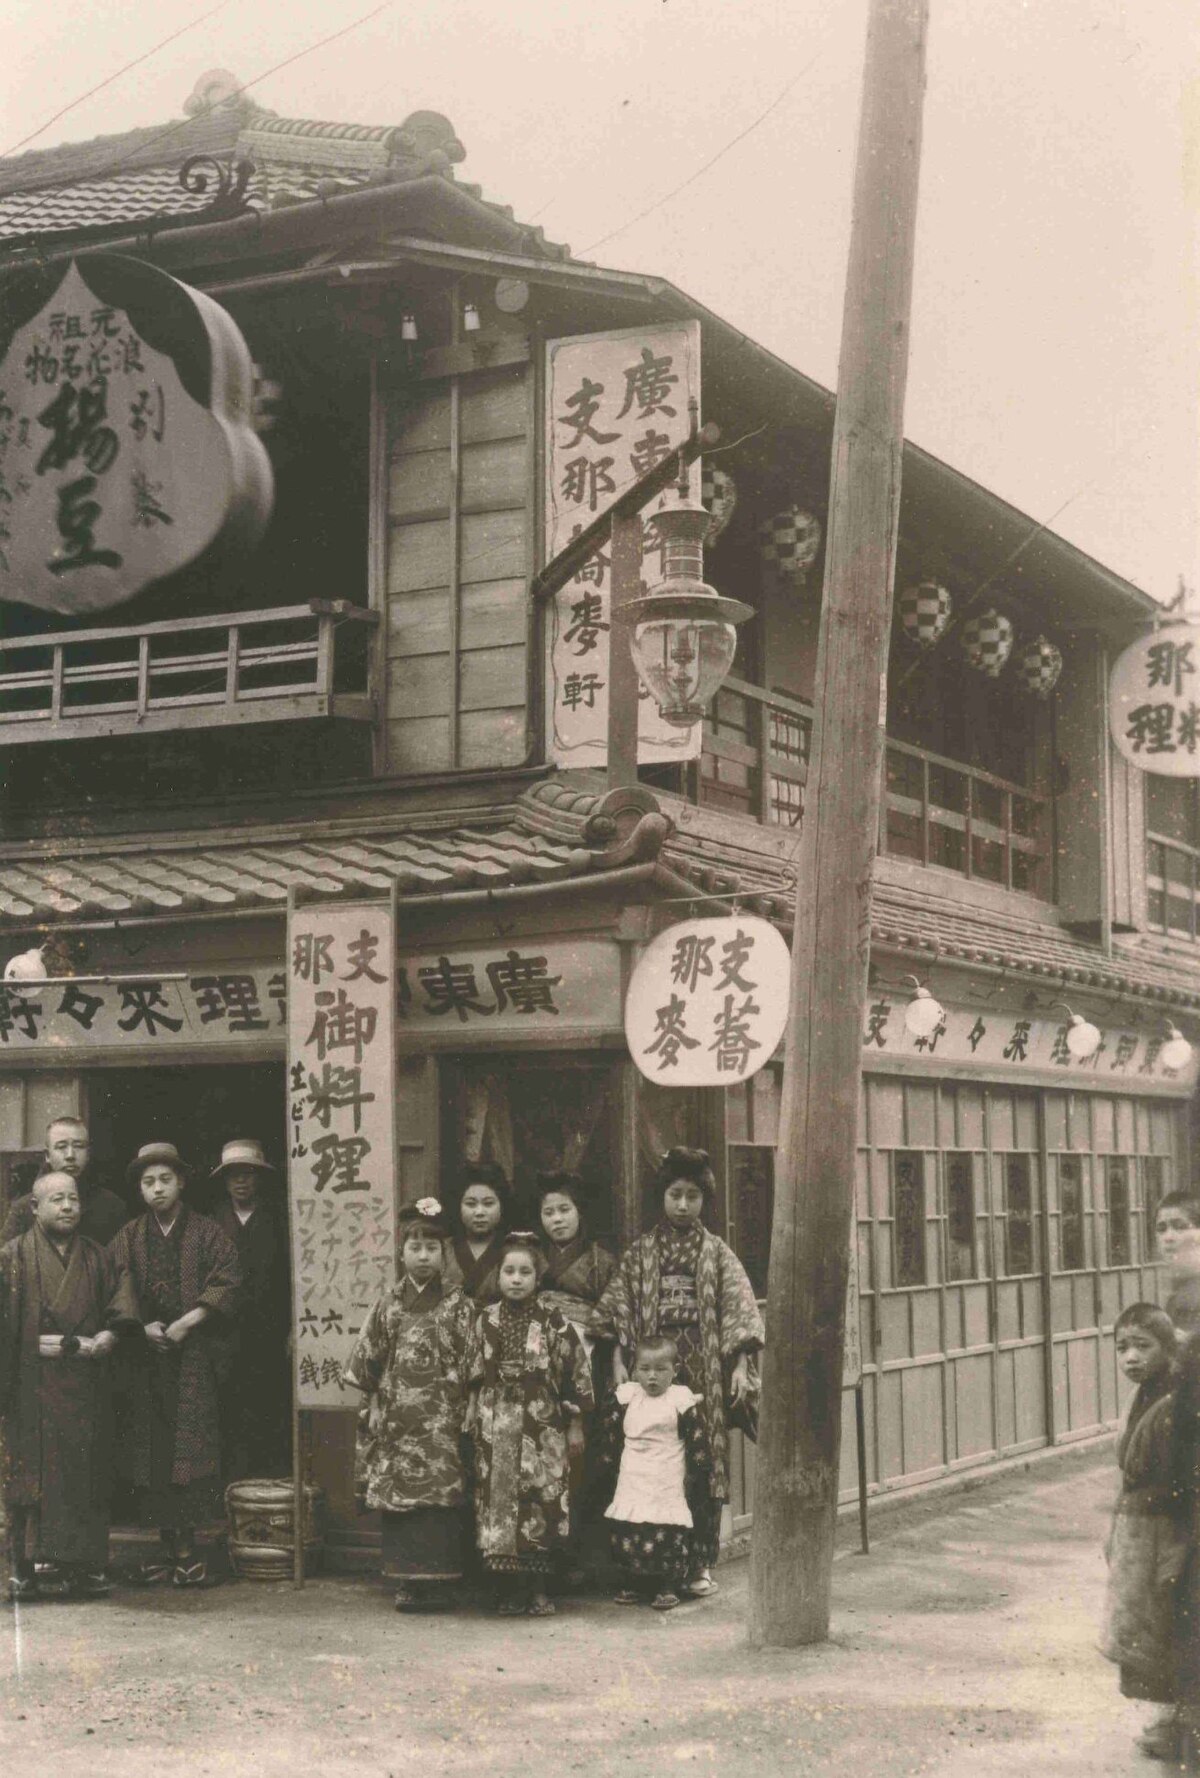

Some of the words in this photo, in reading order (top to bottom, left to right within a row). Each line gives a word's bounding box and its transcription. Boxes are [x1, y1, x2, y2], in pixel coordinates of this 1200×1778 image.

[49, 308, 121, 342] 元祖
[293, 929, 388, 985] 支那
[398, 951, 562, 1023] 廣東
[671, 929, 759, 994] 支那
[290, 1061, 308, 1159] 生ビール
[304, 988, 375, 1195] 御料理
[297, 1199, 319, 1304] ワンタン
